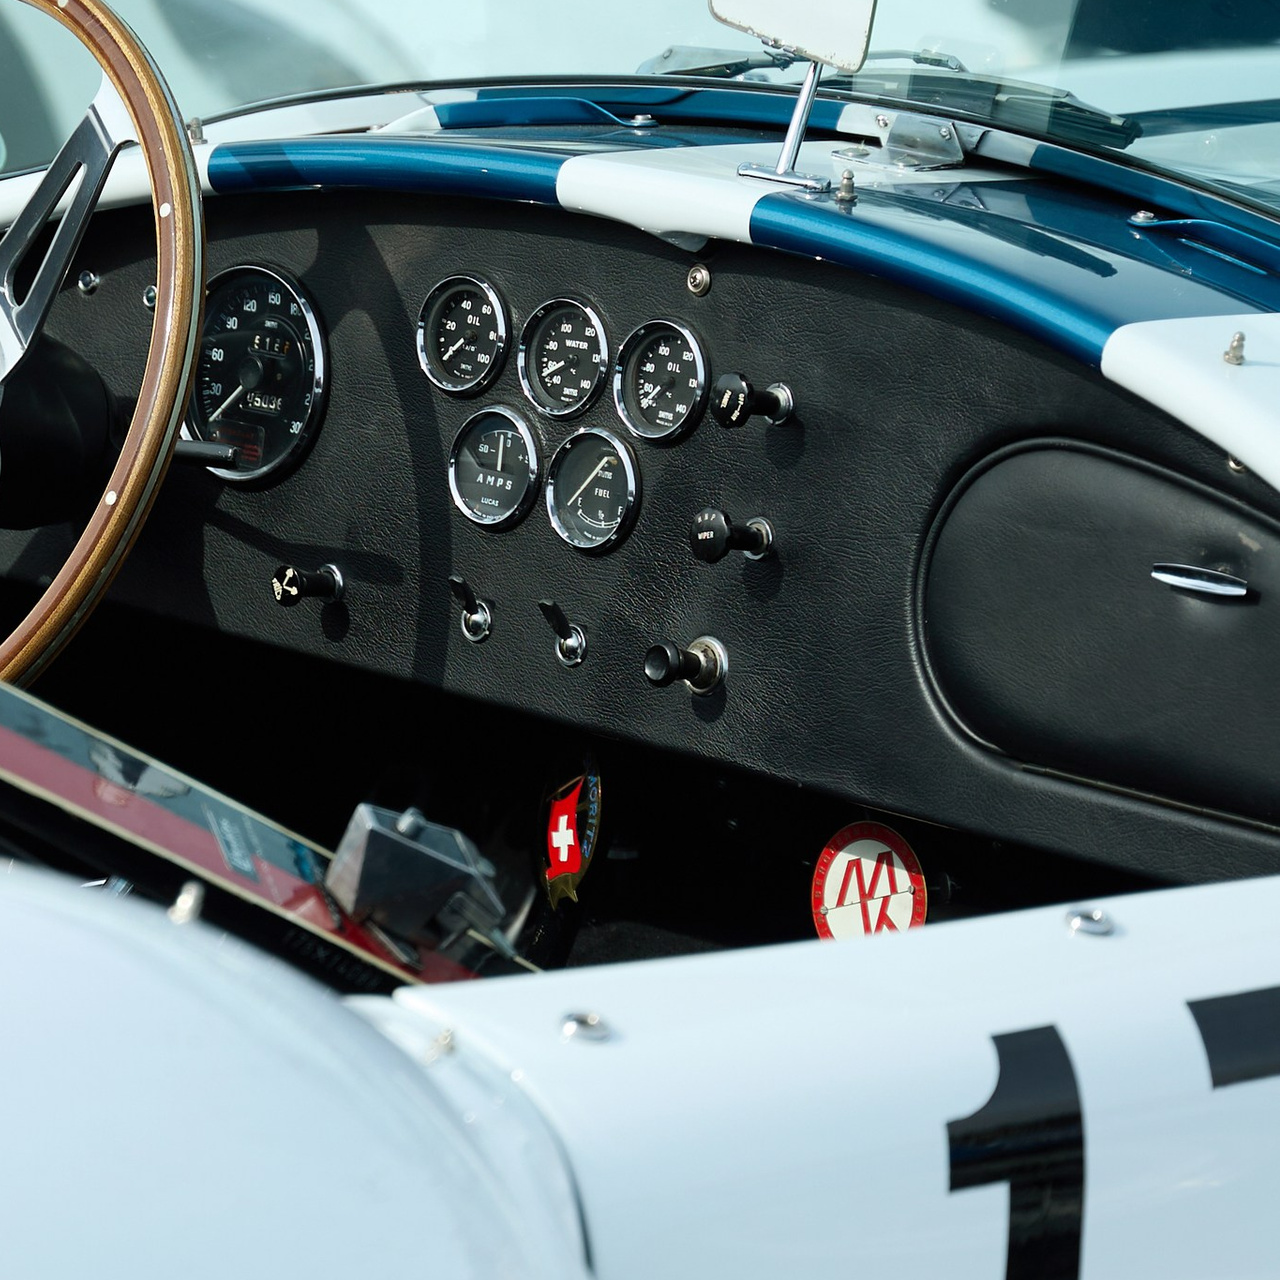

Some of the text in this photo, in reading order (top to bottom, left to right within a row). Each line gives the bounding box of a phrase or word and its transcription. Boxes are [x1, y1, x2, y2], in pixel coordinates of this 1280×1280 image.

[268, 291, 281, 305] 150
[243, 298, 257, 312] 120
[461, 300, 472, 310] 40
[481, 305, 492, 315] 60
[226, 316, 238, 329] 90
[446, 320, 456, 330] 20
[467, 315, 480, 326] OIL
[561, 324, 572, 333] 100
[585, 327, 596, 337] 120
[548, 341, 558, 351] 80
[565, 339, 588, 350] WATER
[211, 348, 224, 361] 60
[659, 346, 670, 356] 100
[477, 353, 490, 364] 100
[682, 351, 694, 362] 120
[645, 363, 655, 373] 80
[667, 362, 681, 373] OIL
[552, 375, 561, 385] 40
[580, 380, 591, 389] 140
[210, 382, 222, 396] 30
[644, 383, 654, 393] 60
[676, 404, 687, 414] 140
[290, 421, 302, 434] 30
[476, 473, 513, 491] AMPS
[594, 488, 610, 499] FUEL
[481, 497, 499, 507] LUCAS
[577, 497, 582, 507] E
[618, 506, 623, 516] F
[698, 531, 714, 540] WIPER
